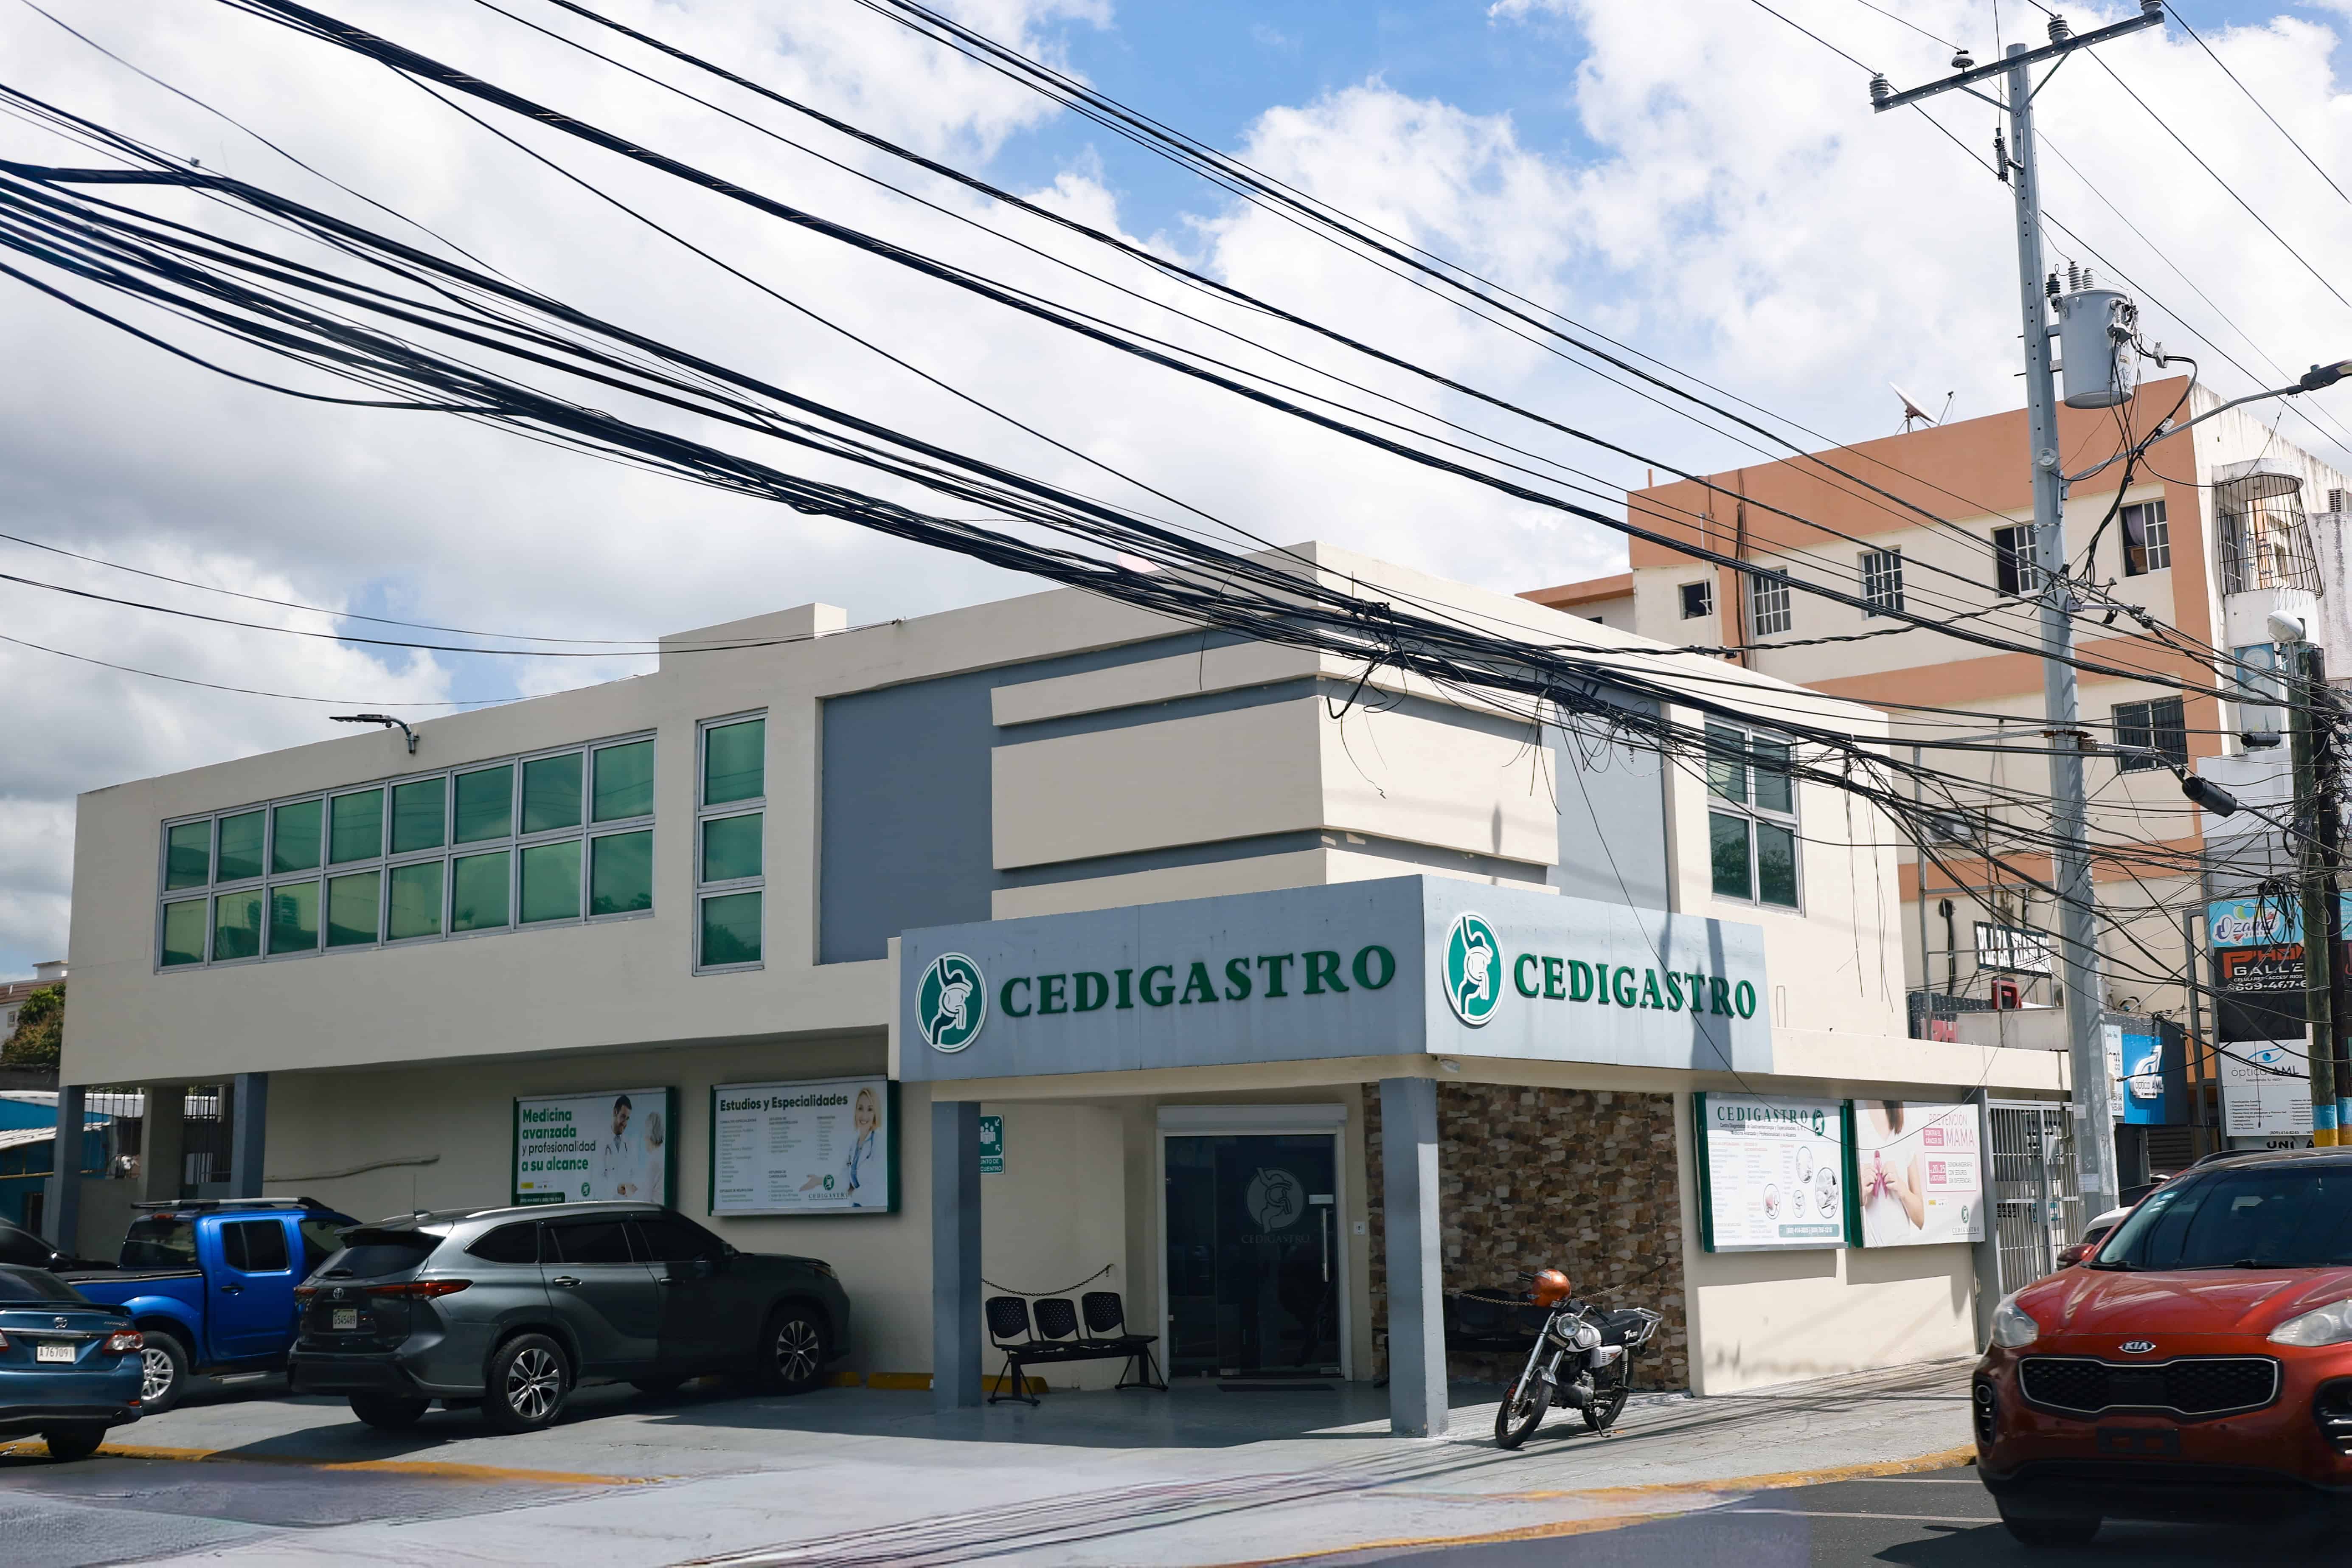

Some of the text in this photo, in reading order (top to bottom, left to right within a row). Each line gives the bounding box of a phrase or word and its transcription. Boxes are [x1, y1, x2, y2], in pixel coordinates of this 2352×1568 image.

[1976, 926, 2011, 968] PLAZA
[2234, 963, 2304, 975] GALLE
[1000, 945, 1395, 1018] CEDIGASTRO
[1514, 953, 1756, 1019] CEDIGASTRO
[2231, 1065, 2299, 1078] óptica AML
[720, 1093, 849, 1111] Estudios y Especialidades
[523, 1107, 572, 1123] Medicina
[1717, 1106, 1808, 1124] CEDIGASTRO
[1929, 1111, 1967, 1126] PREVENCIÓN
[523, 1124, 576, 1139] avanzada
[1946, 1128, 1975, 1146] MAMA
[522, 1140, 596, 1156] y profesionalidad
[522, 1155, 589, 1172] a su alcance
[1241, 1234, 1310, 1244] CEDIGASTRO
[39, 1347, 73, 1358] A767091
[2124, 1342, 2148, 1350] KIA
